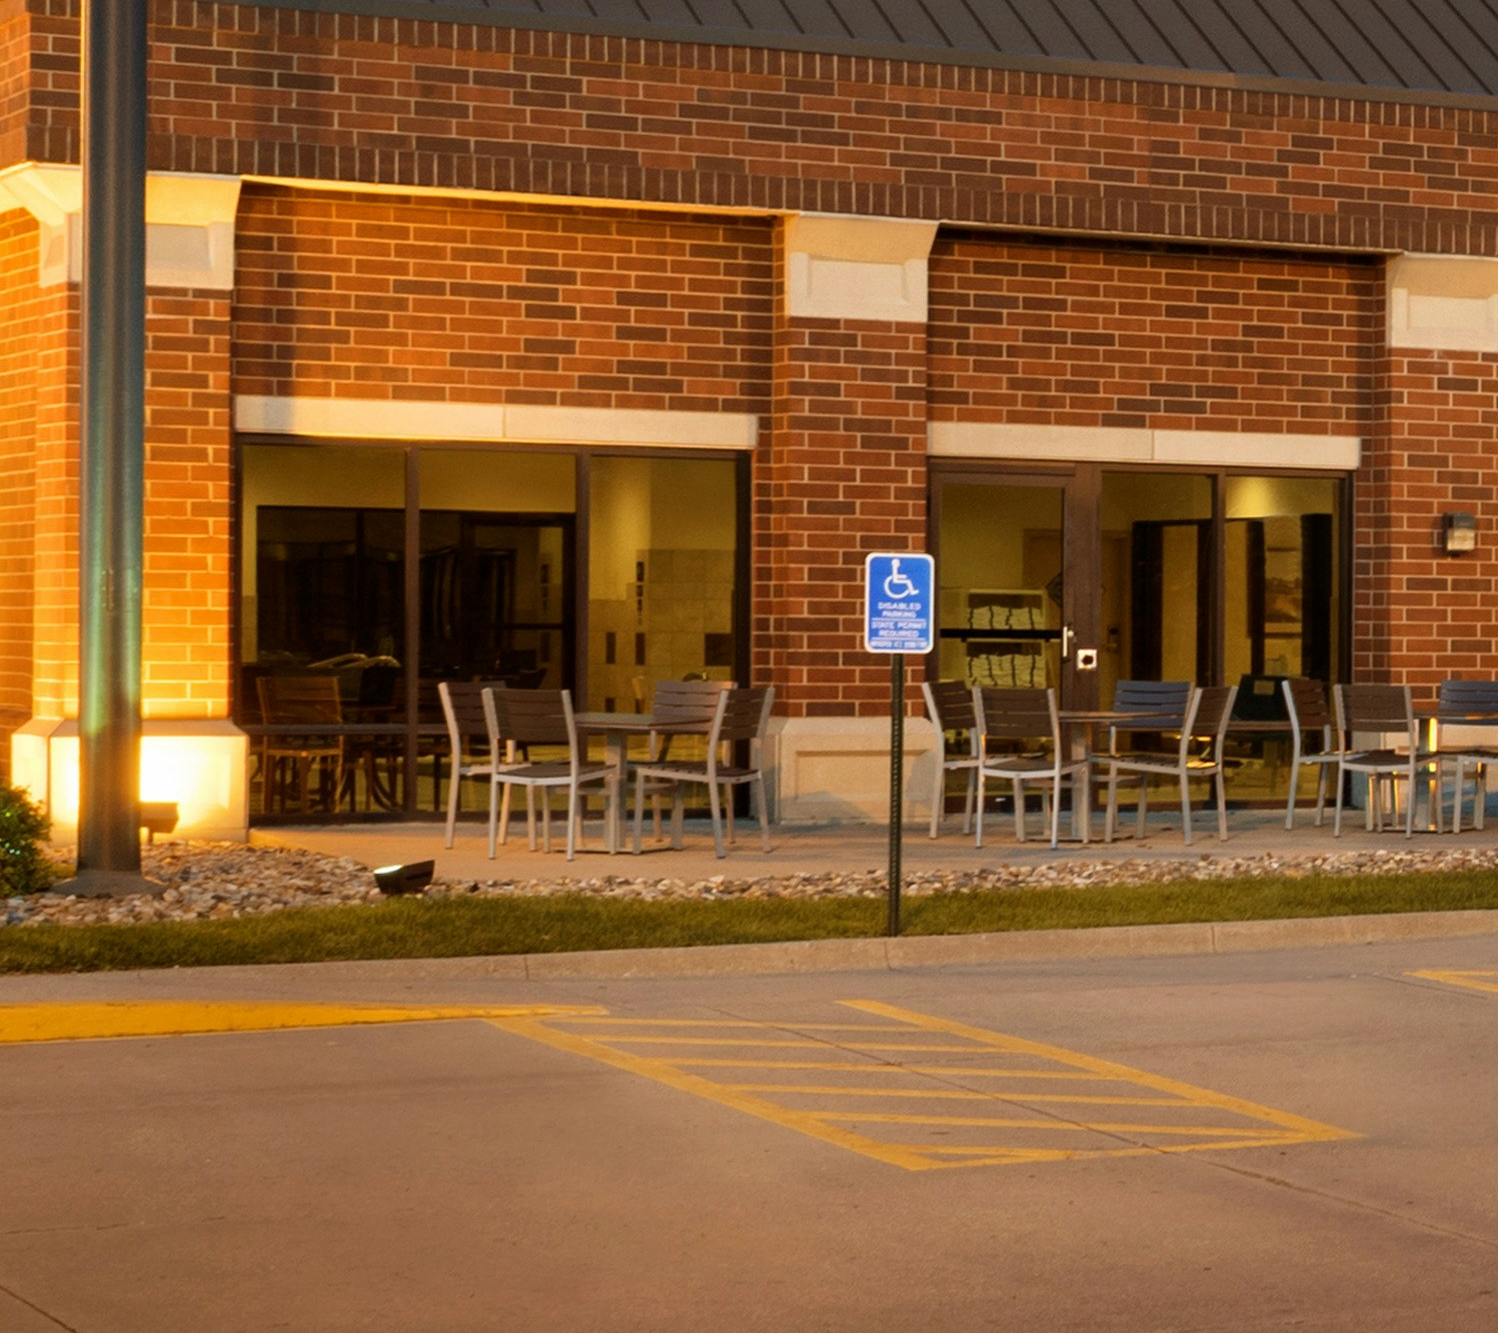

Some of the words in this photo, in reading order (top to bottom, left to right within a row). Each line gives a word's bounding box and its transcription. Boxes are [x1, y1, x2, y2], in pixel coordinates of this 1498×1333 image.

[878, 602, 922, 611] DISABLED
[882, 610, 917, 618] PARKING
[897, 621, 927, 630] PERMIT
